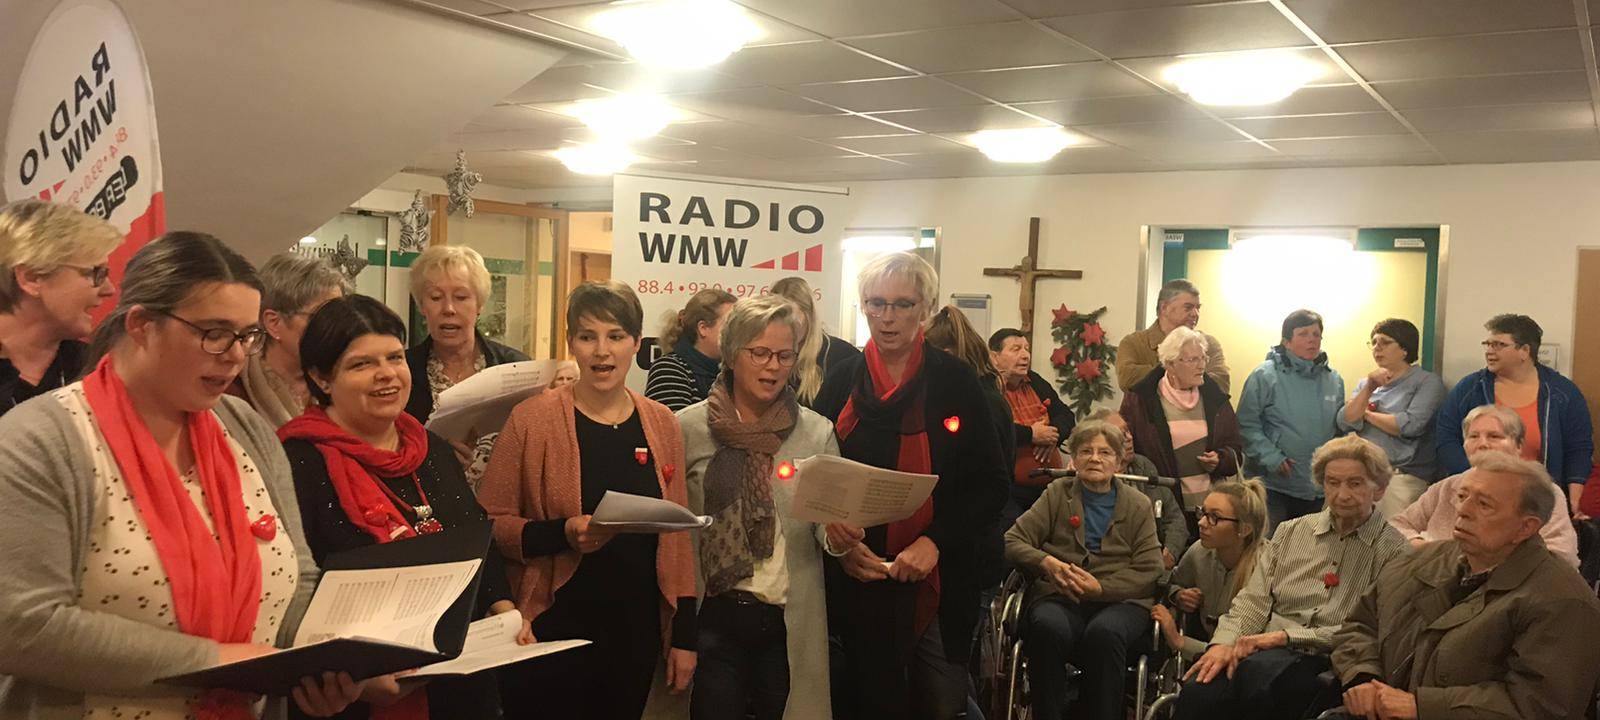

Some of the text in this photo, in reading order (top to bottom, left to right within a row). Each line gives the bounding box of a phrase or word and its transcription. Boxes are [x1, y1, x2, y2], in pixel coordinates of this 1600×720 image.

[639, 192, 825, 234] RADIO
[638, 232, 749, 267] WMW
[638, 280, 674, 294] 88.4
